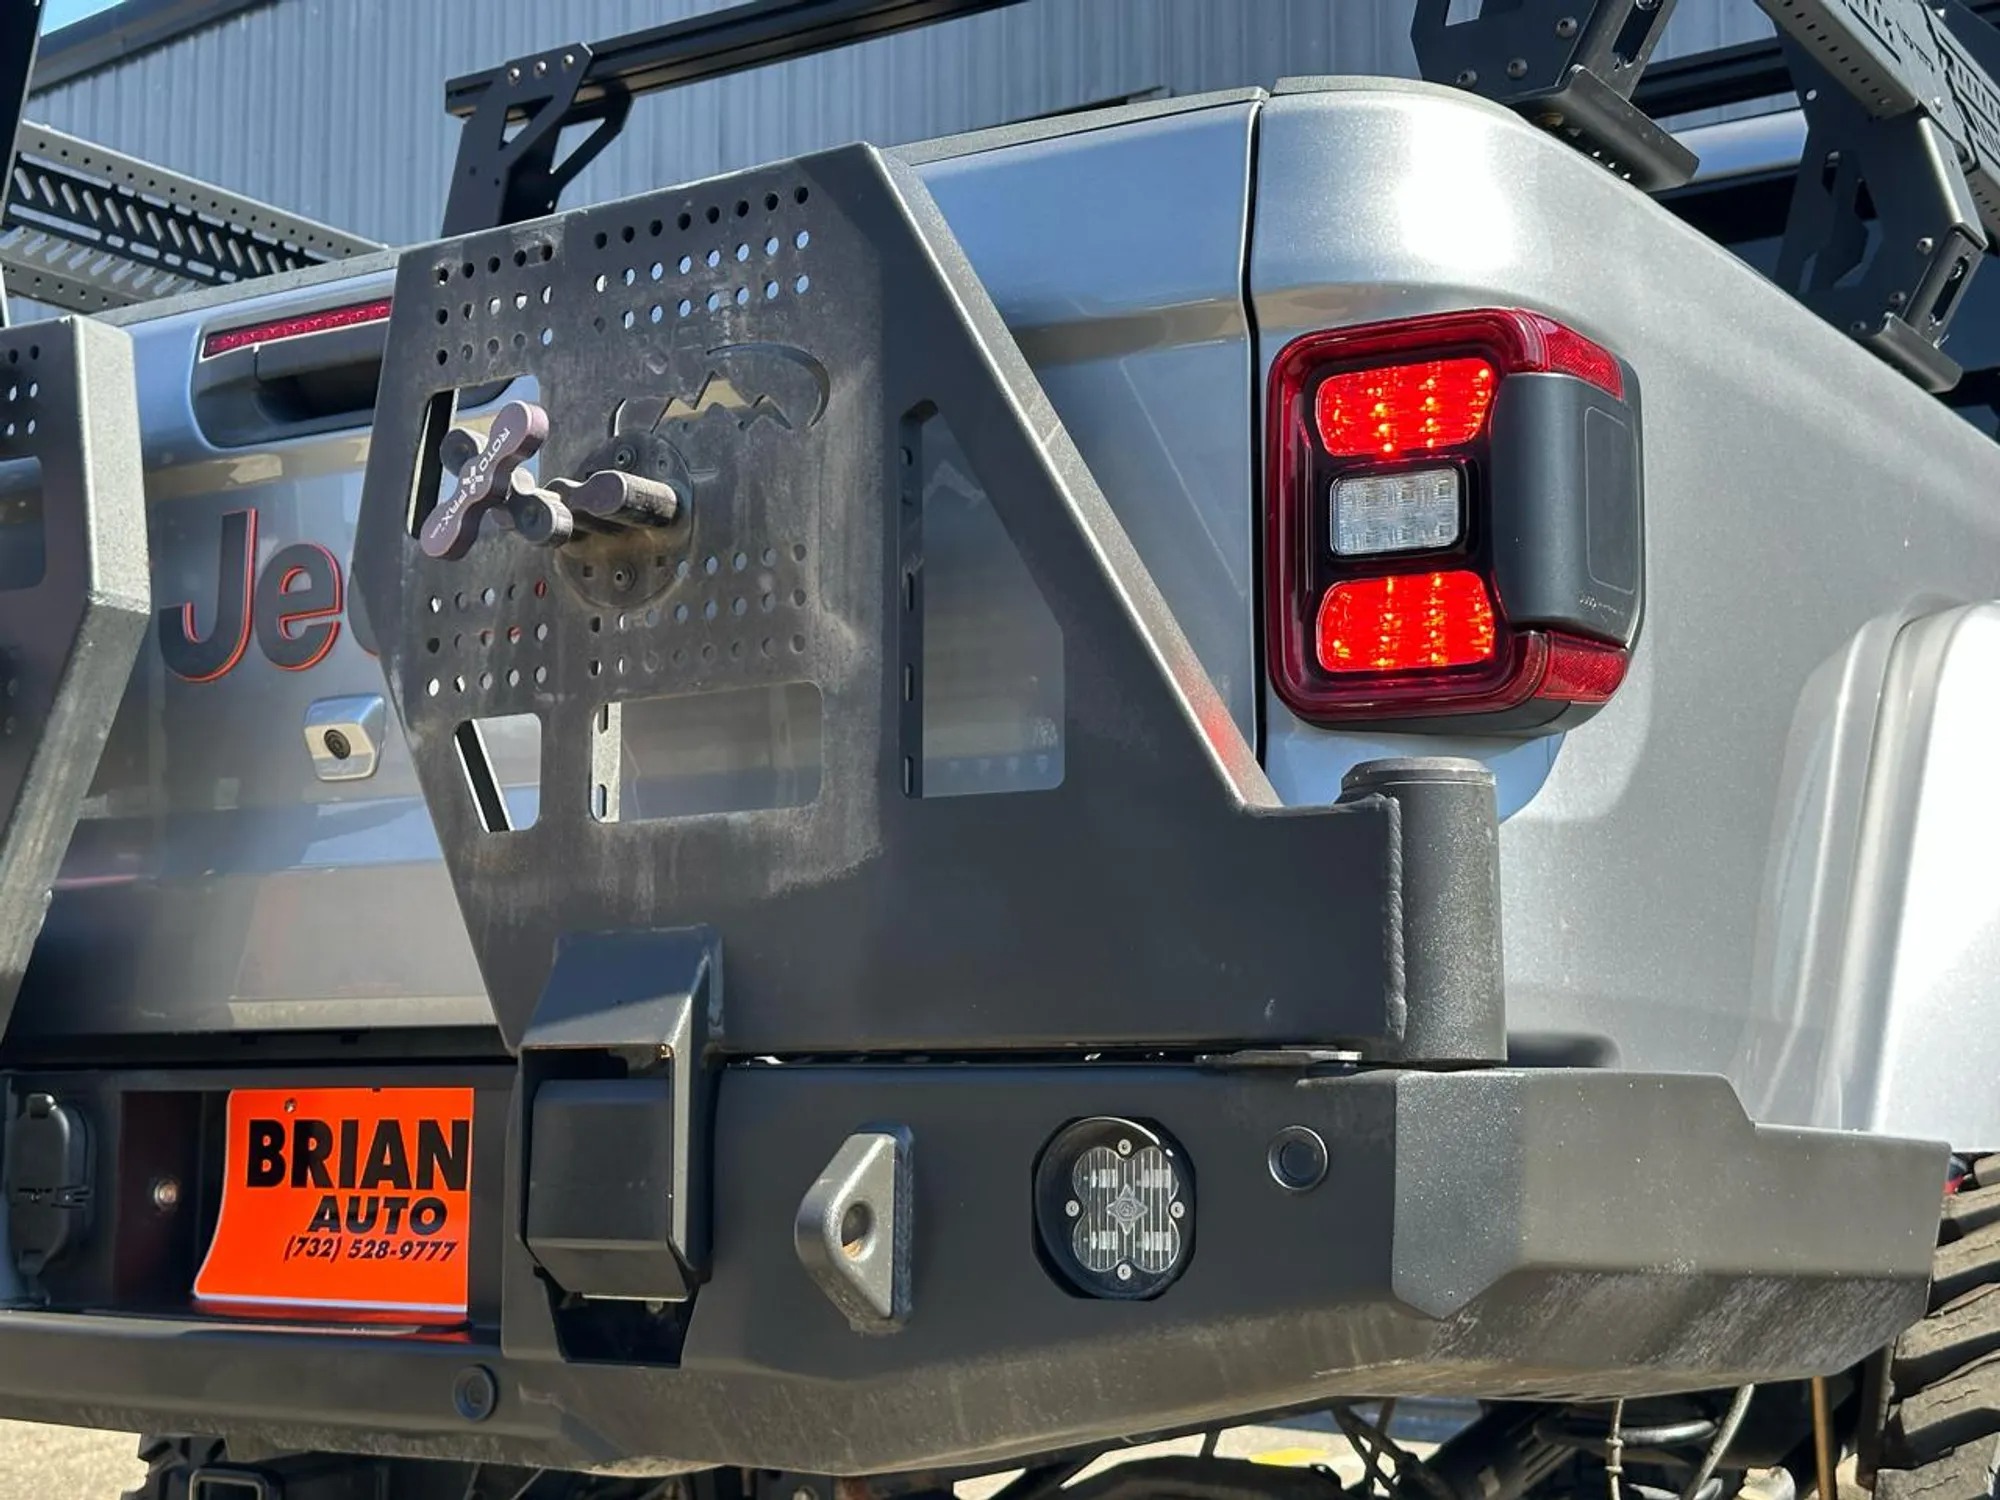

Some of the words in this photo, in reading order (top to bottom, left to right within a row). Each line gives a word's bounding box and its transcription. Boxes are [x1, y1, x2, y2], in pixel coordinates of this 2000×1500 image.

[158, 508, 379, 683] Je
[247, 1119, 469, 1191] BRIAN
[308, 1195, 447, 1235] AUTO
[284, 1236, 342, 1263] (732)
[347, 1240, 457, 1262] 528-9777
